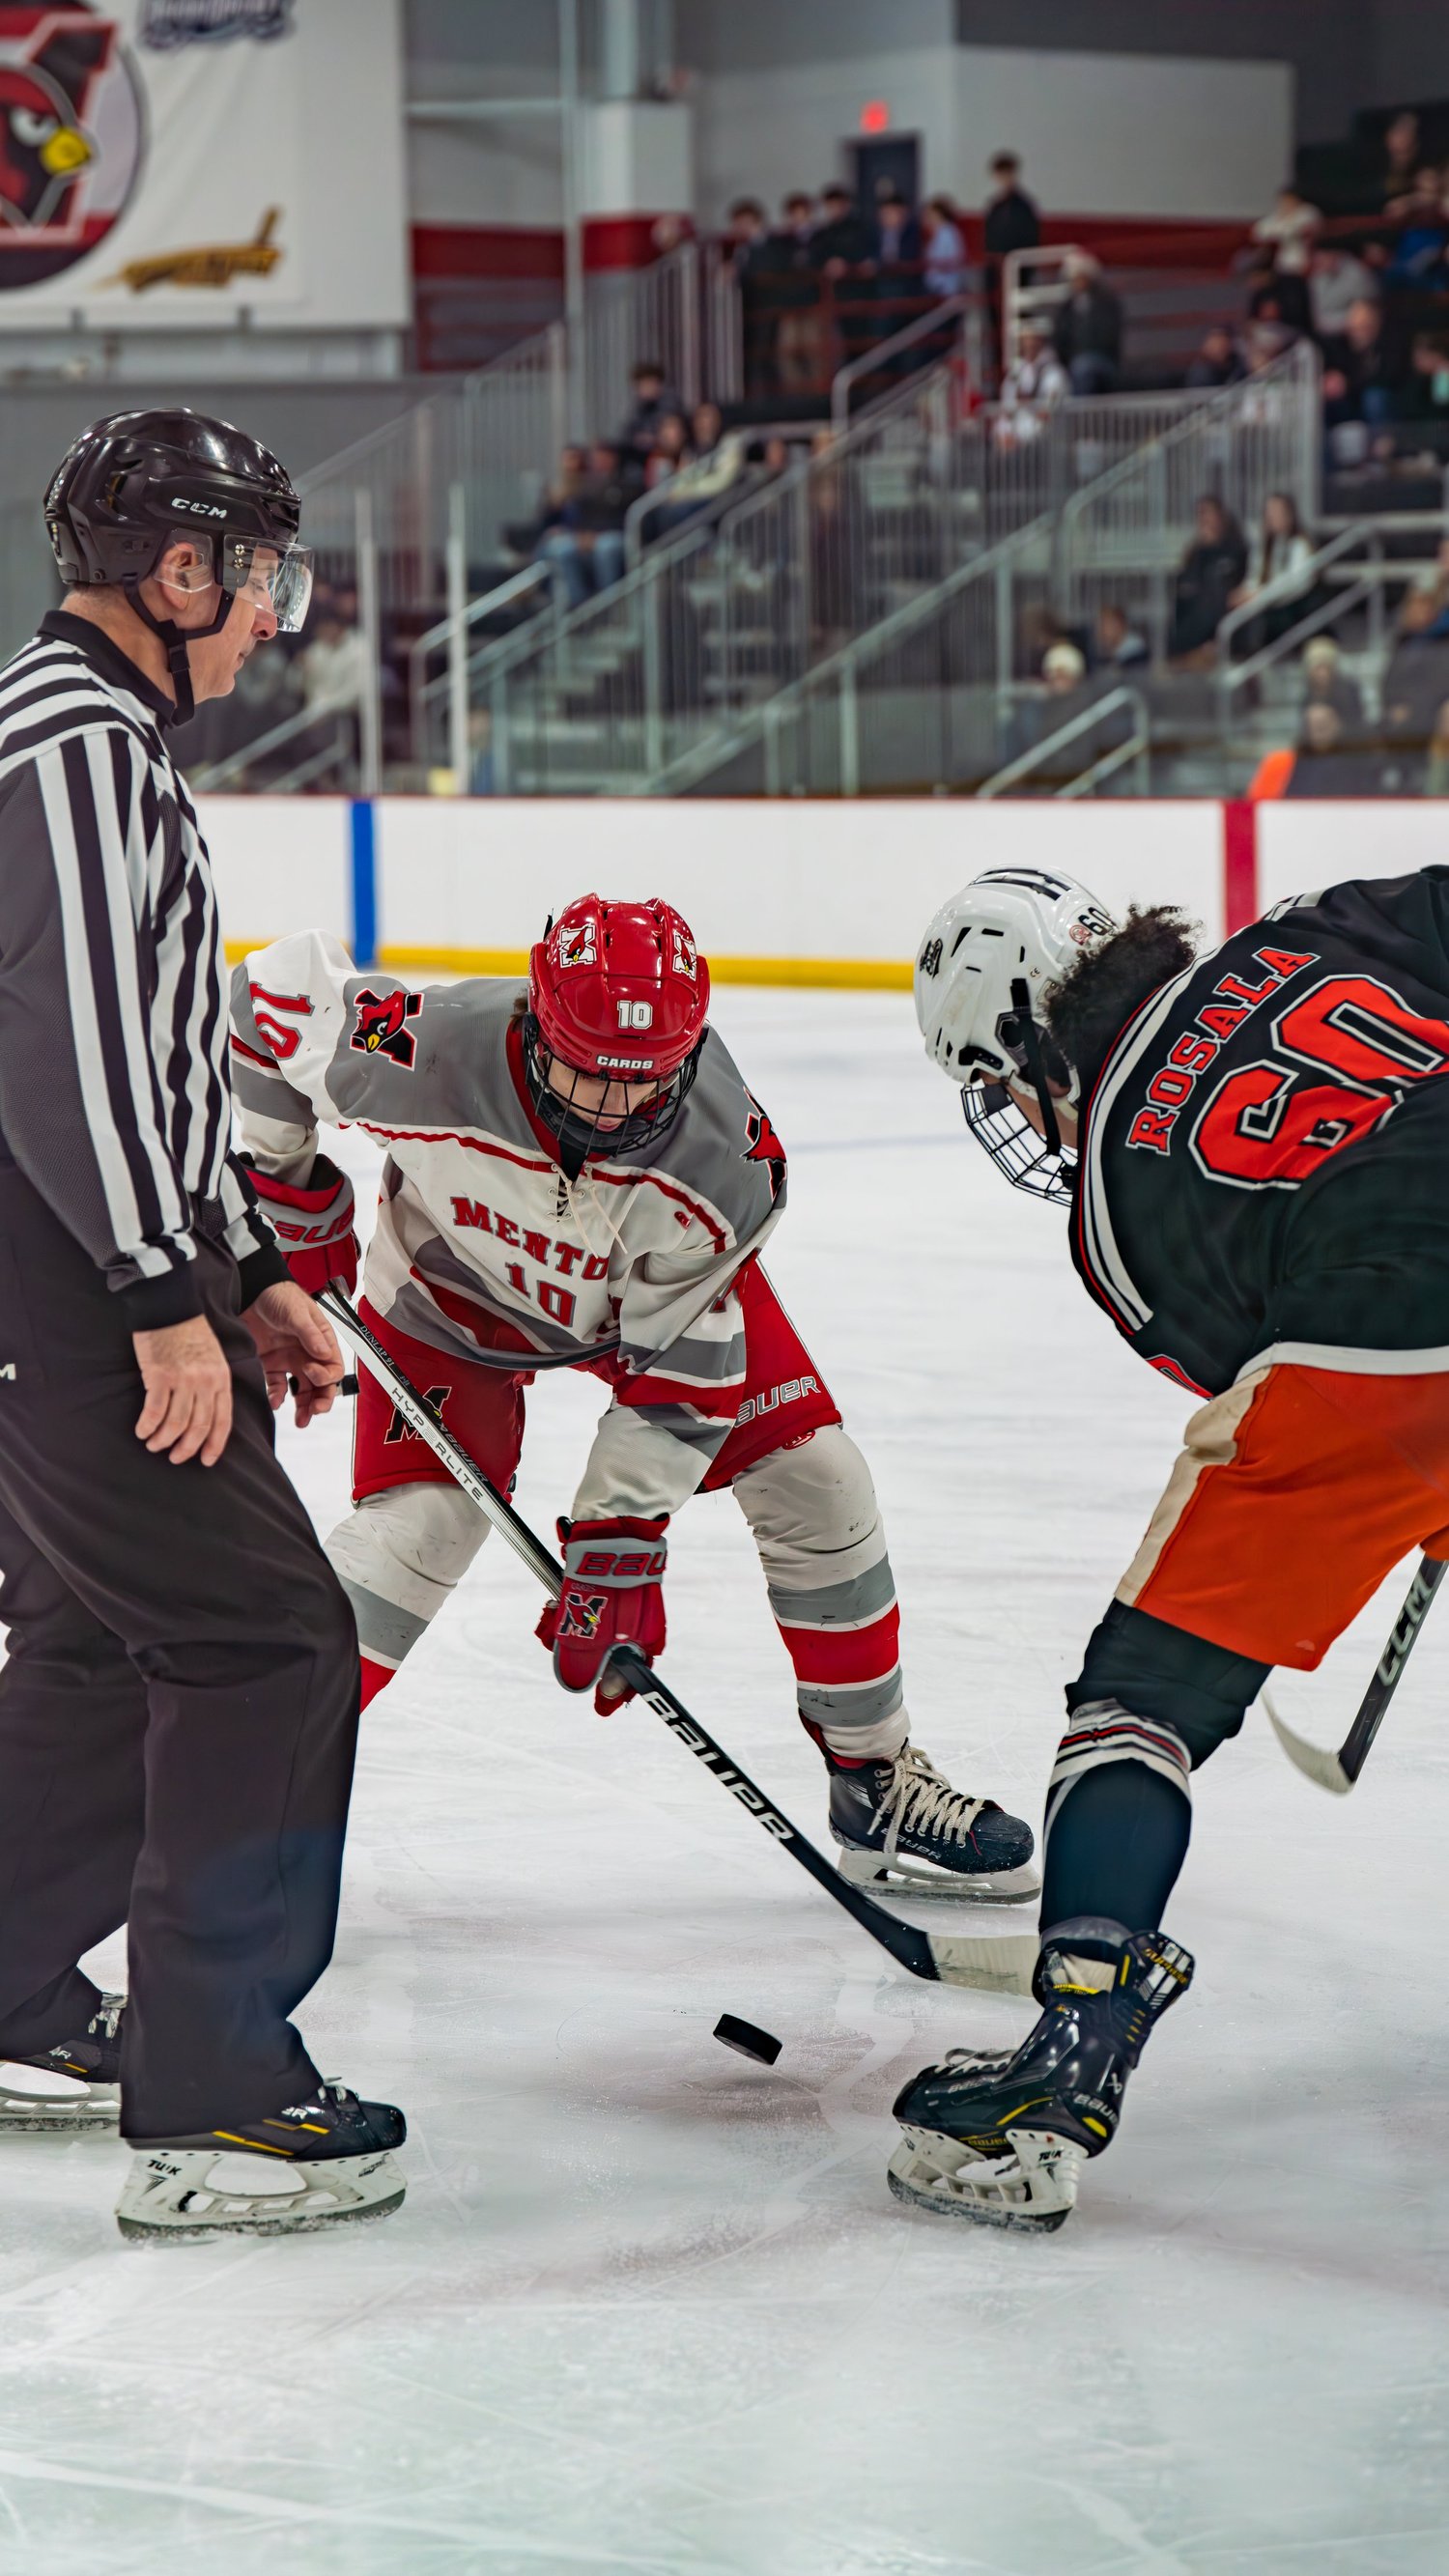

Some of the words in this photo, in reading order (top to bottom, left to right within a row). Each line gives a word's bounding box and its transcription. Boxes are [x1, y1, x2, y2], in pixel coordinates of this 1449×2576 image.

[171, 497, 228, 519] CCM
[1077, 906, 1118, 936] 60
[616, 1000, 653, 1030] 10
[596, 1055, 654, 1069] CARDS
[1124, 946, 1321, 1156] ROSALA
[1188, 974, 1449, 1191] 60
[504, 1261, 577, 1328] 10
[359, 1325, 387, 1357] DUNLAP
